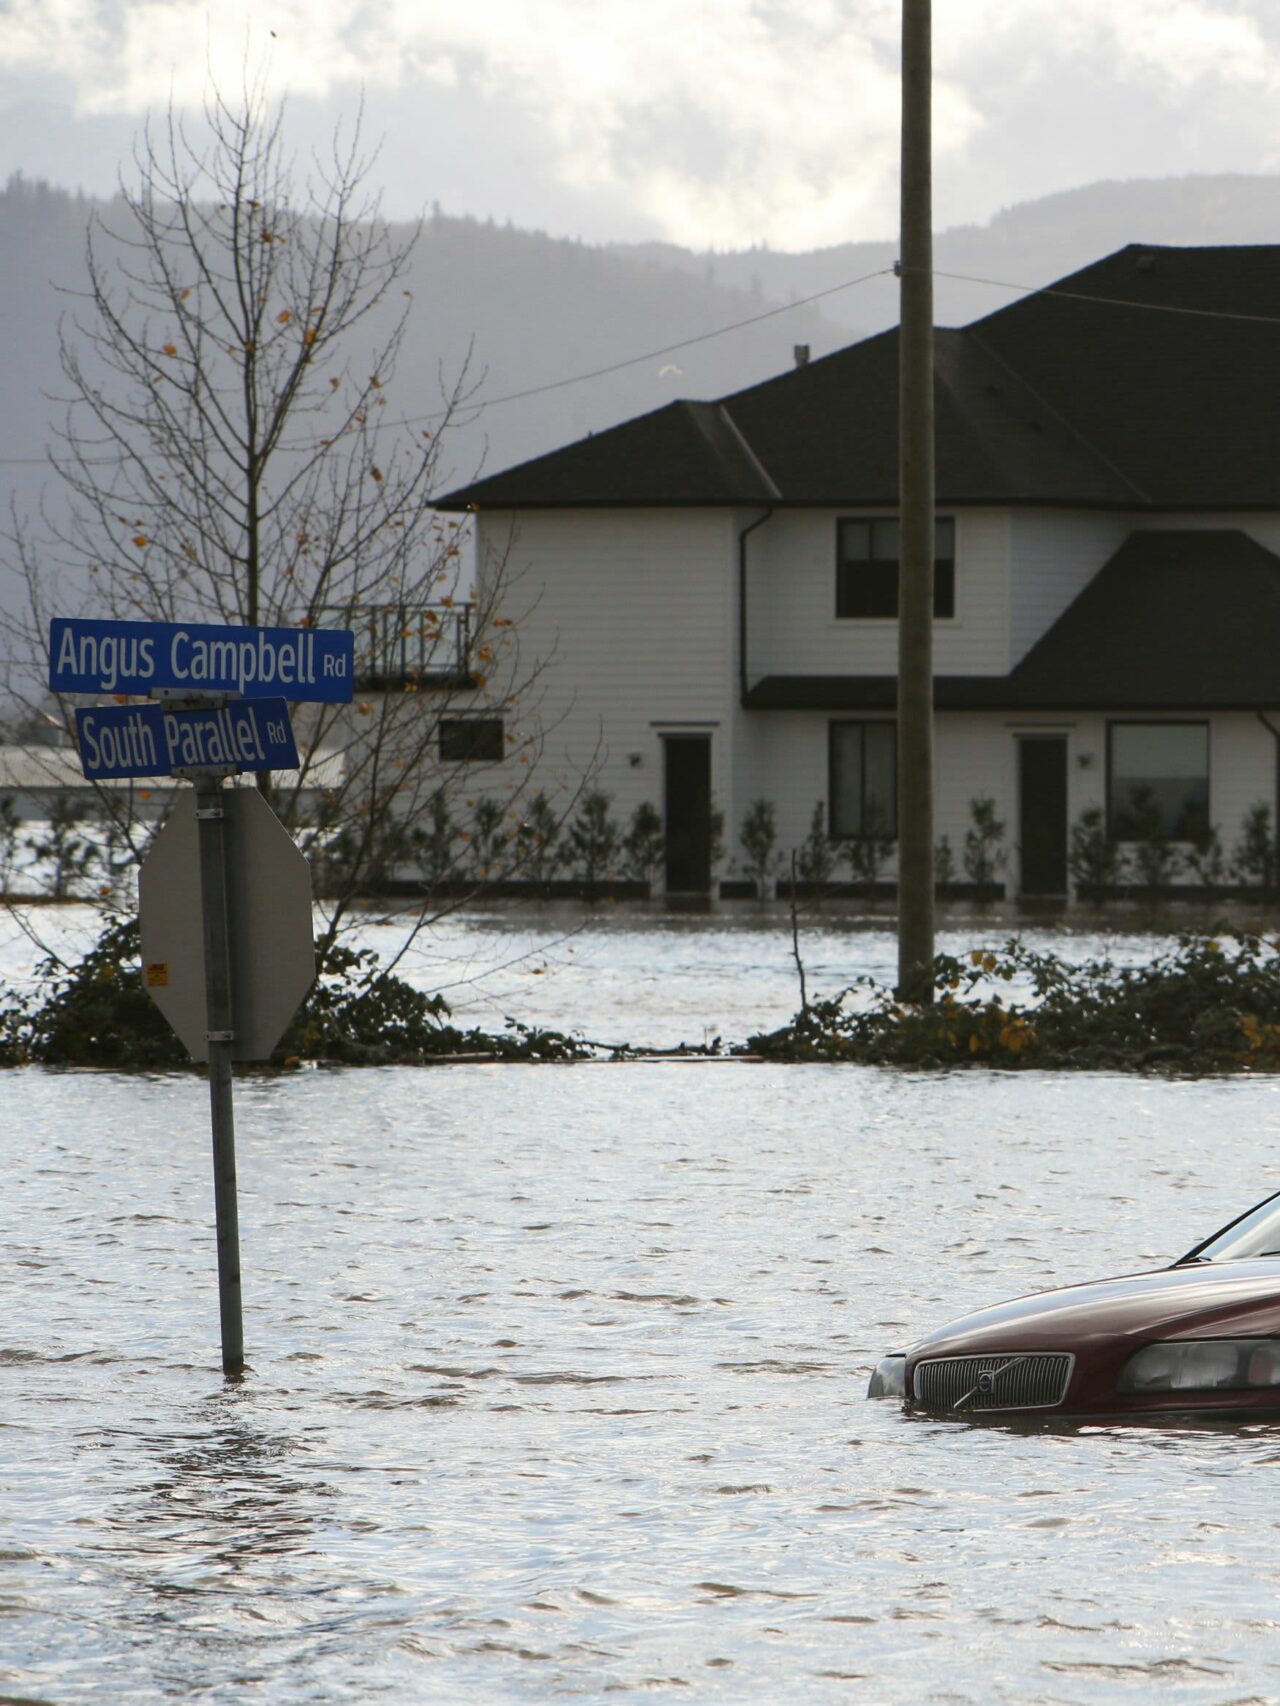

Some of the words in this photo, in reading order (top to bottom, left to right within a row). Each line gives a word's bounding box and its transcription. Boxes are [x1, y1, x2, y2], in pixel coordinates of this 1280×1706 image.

[57, 627, 155, 690] Angus
[171, 631, 316, 695] Campbell
[323, 653, 346, 678] Rd
[83, 713, 158, 770] South
[164, 707, 266, 765] Parallel
[267, 721, 287, 745] Rd
